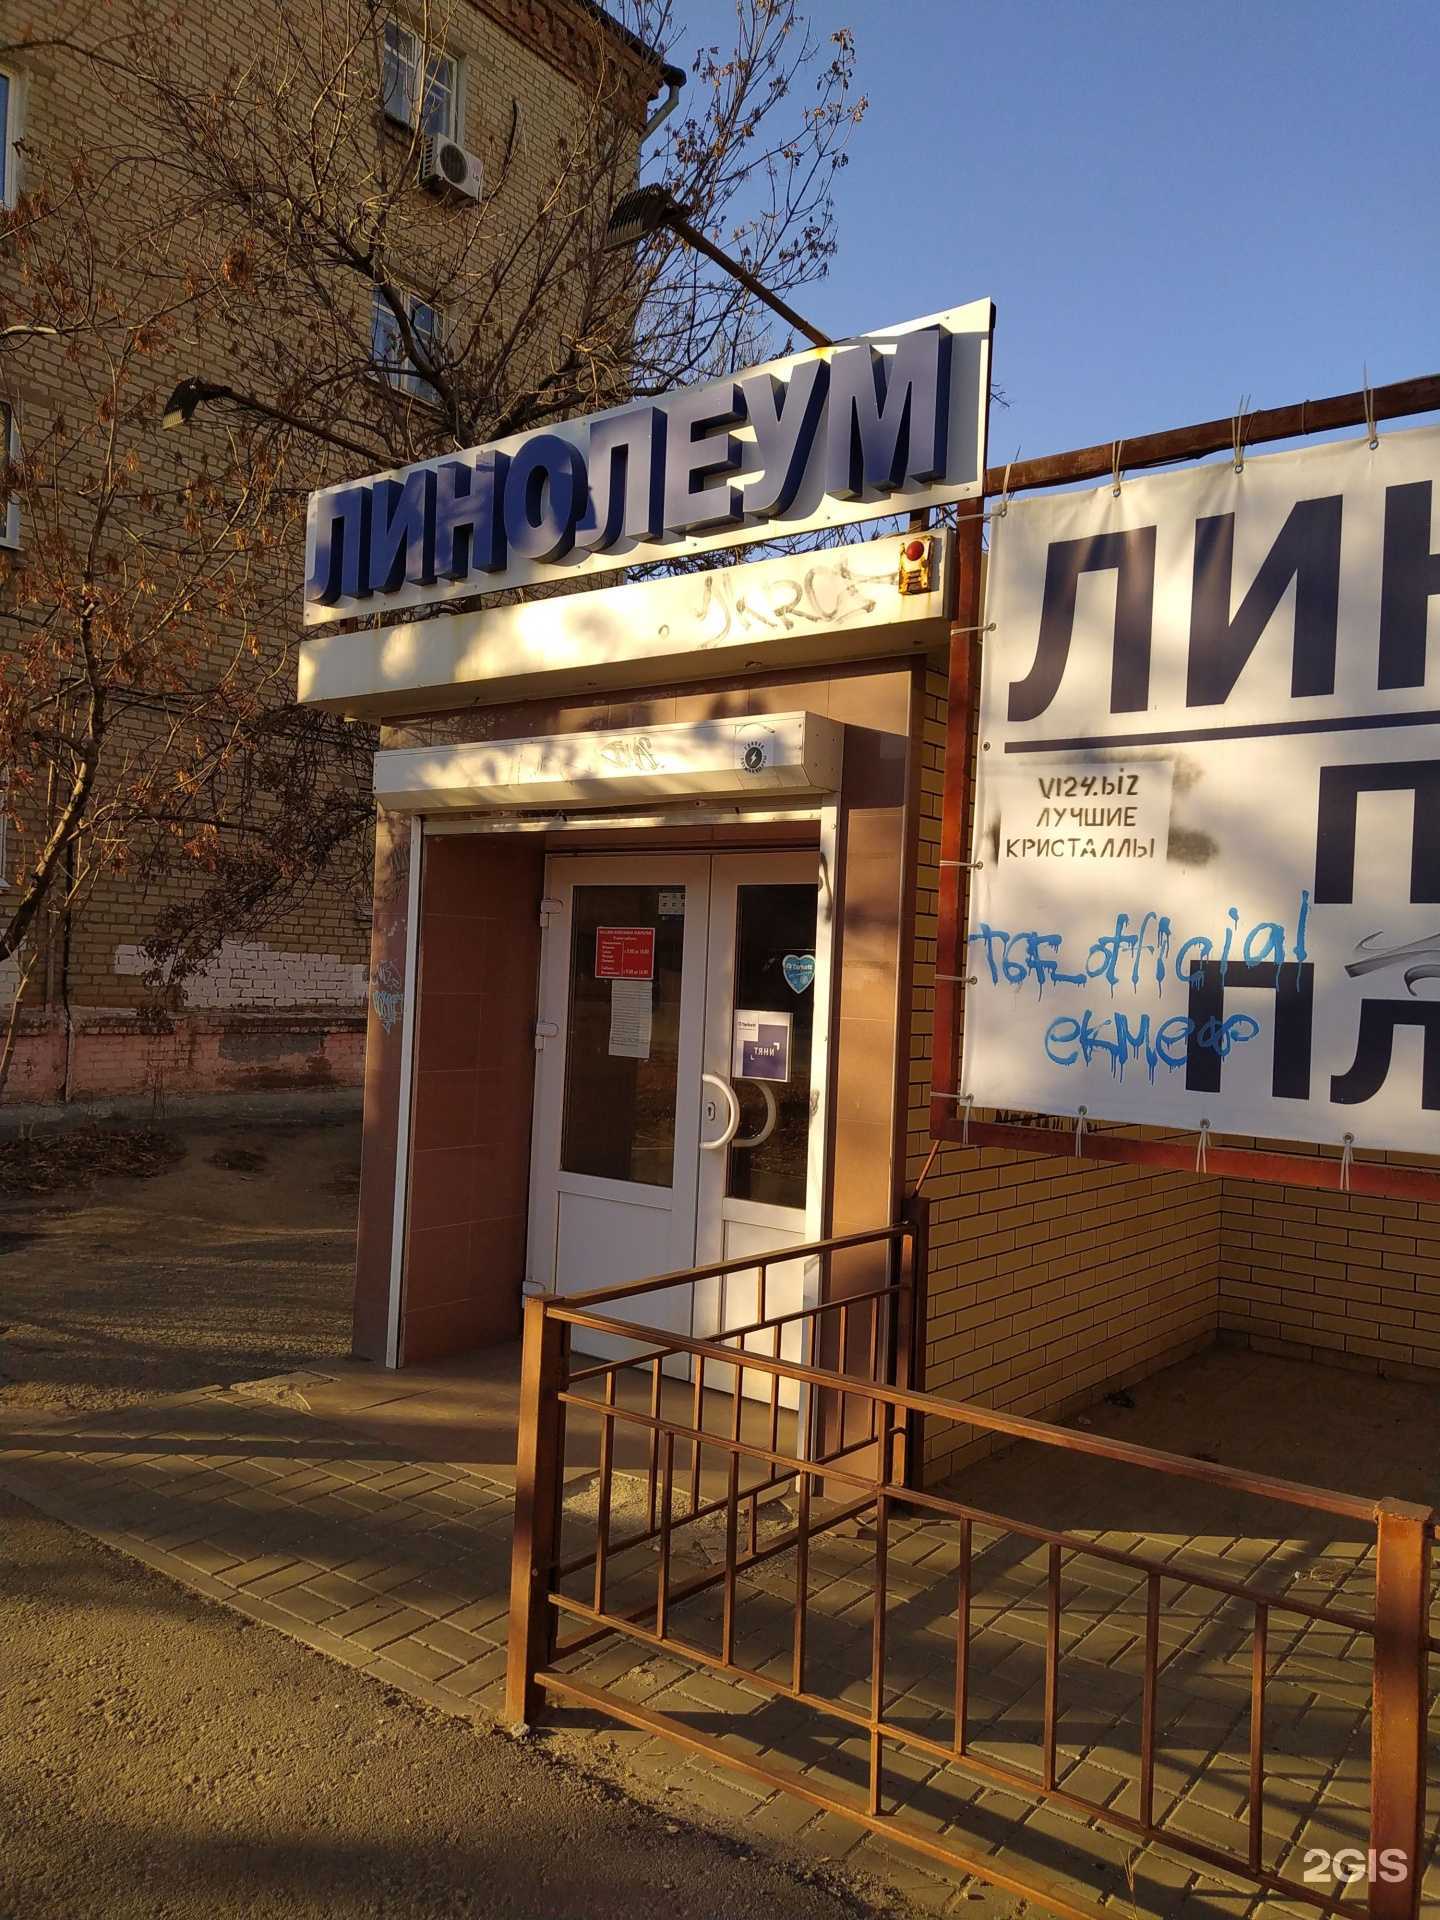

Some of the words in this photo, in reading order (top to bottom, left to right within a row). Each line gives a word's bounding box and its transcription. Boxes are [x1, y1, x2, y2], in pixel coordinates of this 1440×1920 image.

[306, 324, 953, 602] ЛИНОЛЕУМ
[1036, 806, 1138, 828] ЛУЧШИЕ
[1006, 837, 1155, 858] КРИСТАЛЛЫ
[754, 1046, 775, 1057] ТЯНИ
